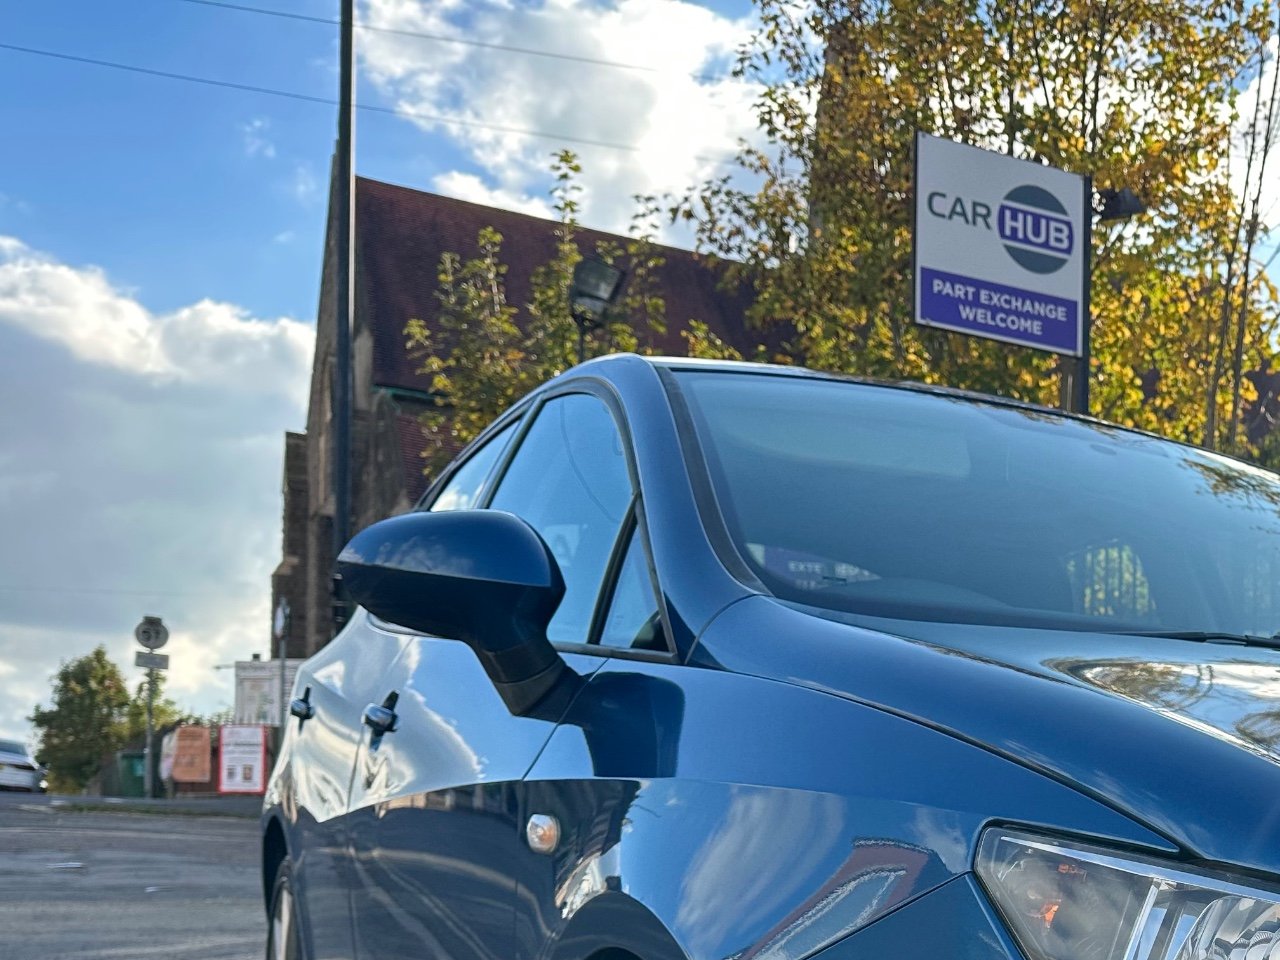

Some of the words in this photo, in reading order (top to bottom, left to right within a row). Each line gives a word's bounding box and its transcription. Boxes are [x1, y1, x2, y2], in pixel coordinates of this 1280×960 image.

[927, 191, 993, 230] CAR
[1003, 209, 1070, 250] HUB
[932, 279, 977, 301] PART
[979, 288, 1067, 322] EXCHANGE
[958, 304, 1043, 335] WELCOME
